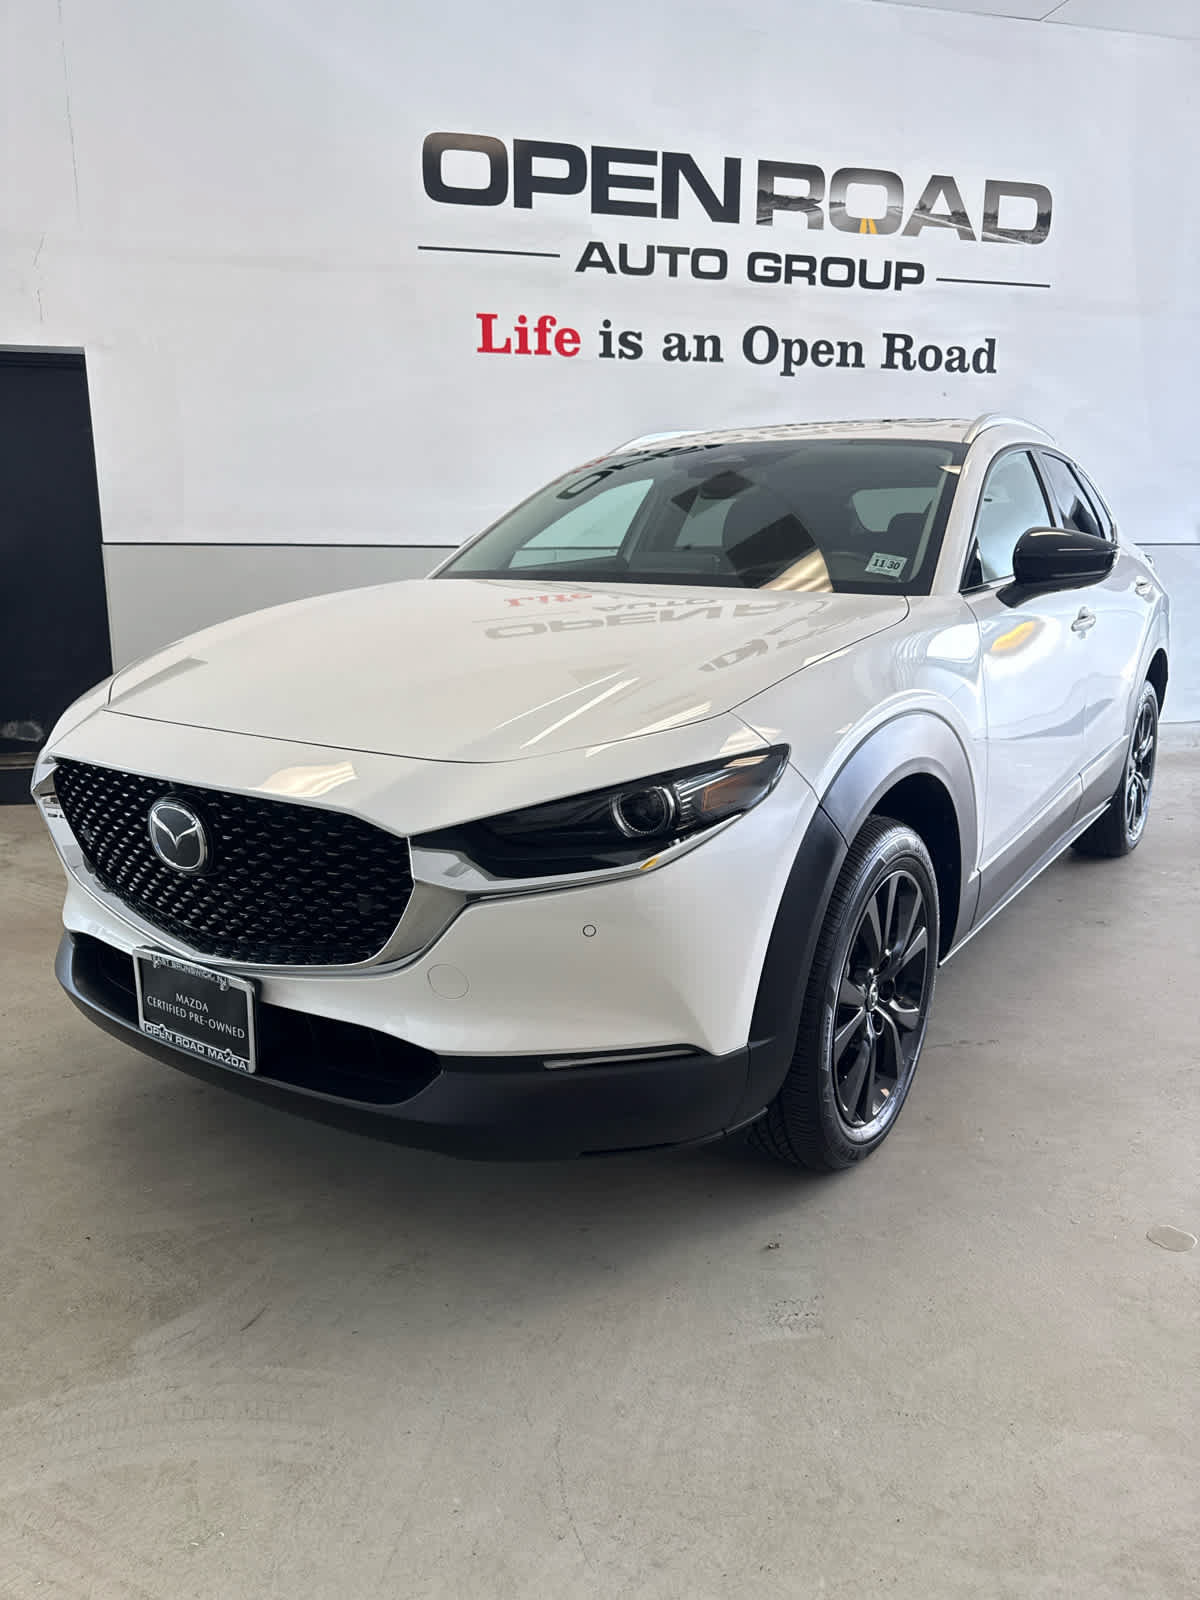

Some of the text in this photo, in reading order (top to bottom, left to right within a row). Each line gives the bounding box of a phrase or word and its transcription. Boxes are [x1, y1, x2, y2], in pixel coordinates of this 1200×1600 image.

[422, 132, 1053, 245] OPEN ROAD
[575, 241, 925, 291] AUTO GROUP
[476, 313, 997, 377] Life is an Open Road
[146, 995, 245, 1039] CERTIFIED PRE-OWNED
[175, 992, 209, 1013] MAZDA
[145, 1023, 246, 1070] OPEN ROAD MAZDA
